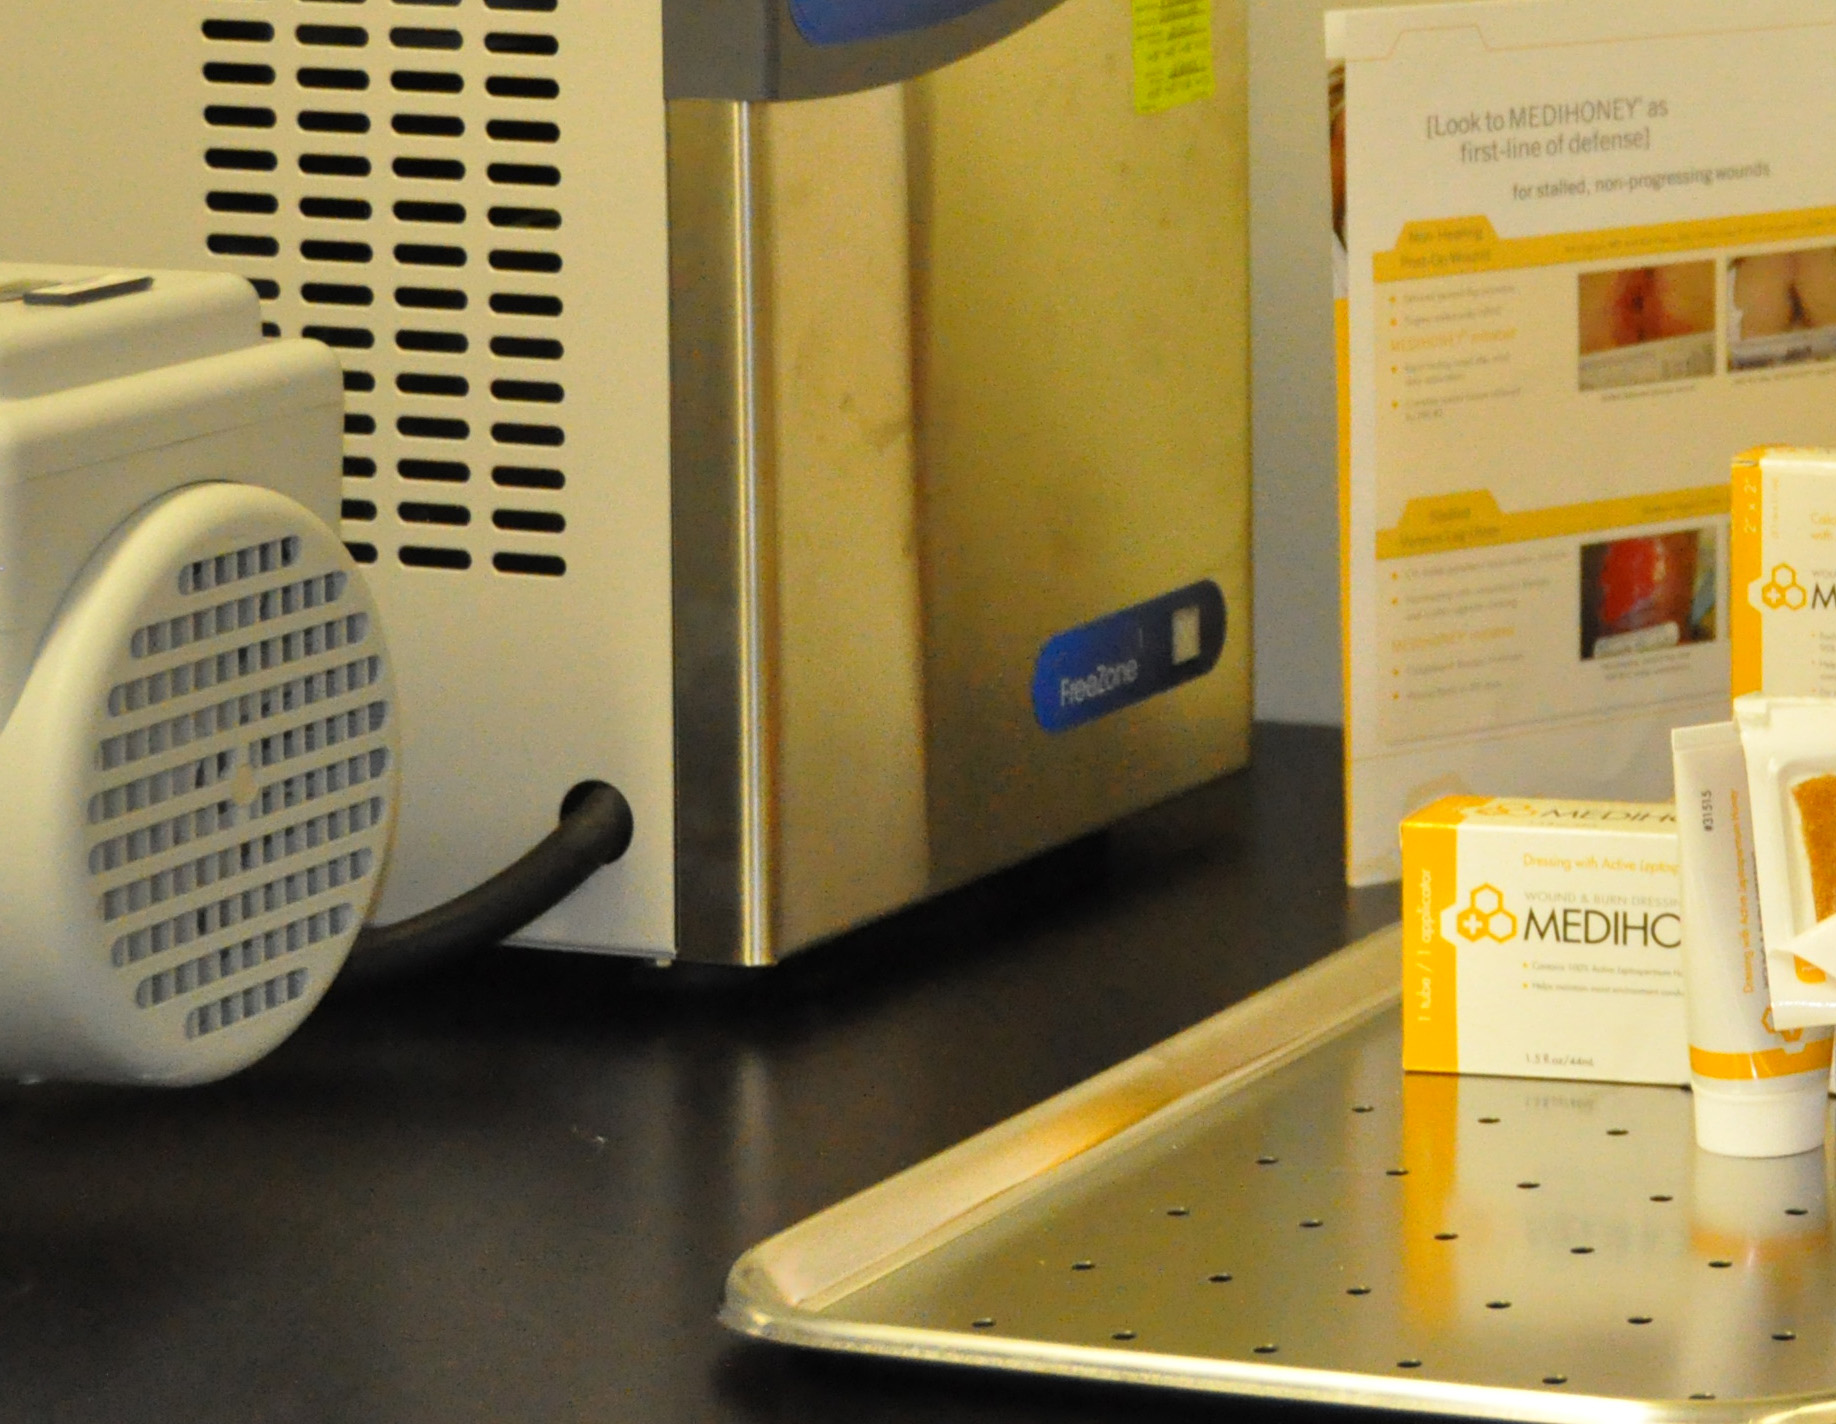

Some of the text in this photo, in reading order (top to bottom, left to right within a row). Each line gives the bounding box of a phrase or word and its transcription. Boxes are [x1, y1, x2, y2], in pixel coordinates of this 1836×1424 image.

[1427, 111, 1482, 140] [Look
[1484, 110, 1505, 133] to
[1648, 98, 1669, 118] as
[1460, 126, 1651, 164] first-line of defense]
[1512, 183, 1533, 201] for
[1594, 165, 1714, 195] non-progressing
[1715, 159, 1771, 183] wounds
[1523, 853, 1572, 872] Dressing
[1574, 854, 1599, 868] with
[1601, 854, 1636, 871] Active
[1416, 868, 1435, 944] applicator
[1524, 891, 1577, 903] WOUND
[1580, 892, 1590, 903] &
[1593, 893, 1628, 905] BURN
